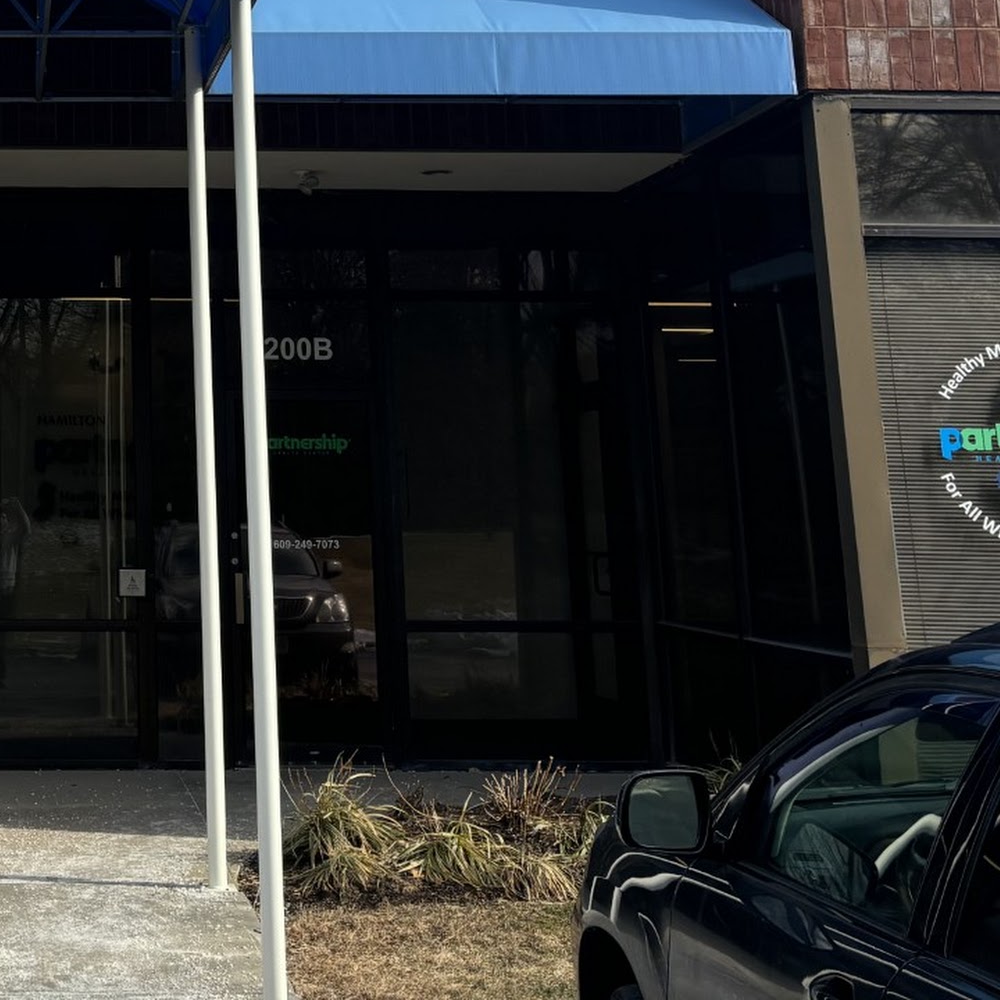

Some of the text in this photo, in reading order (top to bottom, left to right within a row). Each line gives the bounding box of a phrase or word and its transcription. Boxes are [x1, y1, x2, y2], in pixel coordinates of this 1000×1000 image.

[265, 336, 335, 361] 200B
[938, 353, 985, 400] Healthy
[268, 433, 350, 456] artnership
[940, 472, 1000, 539] For All W
[273, 539, 340, 550] 609-249-7073
